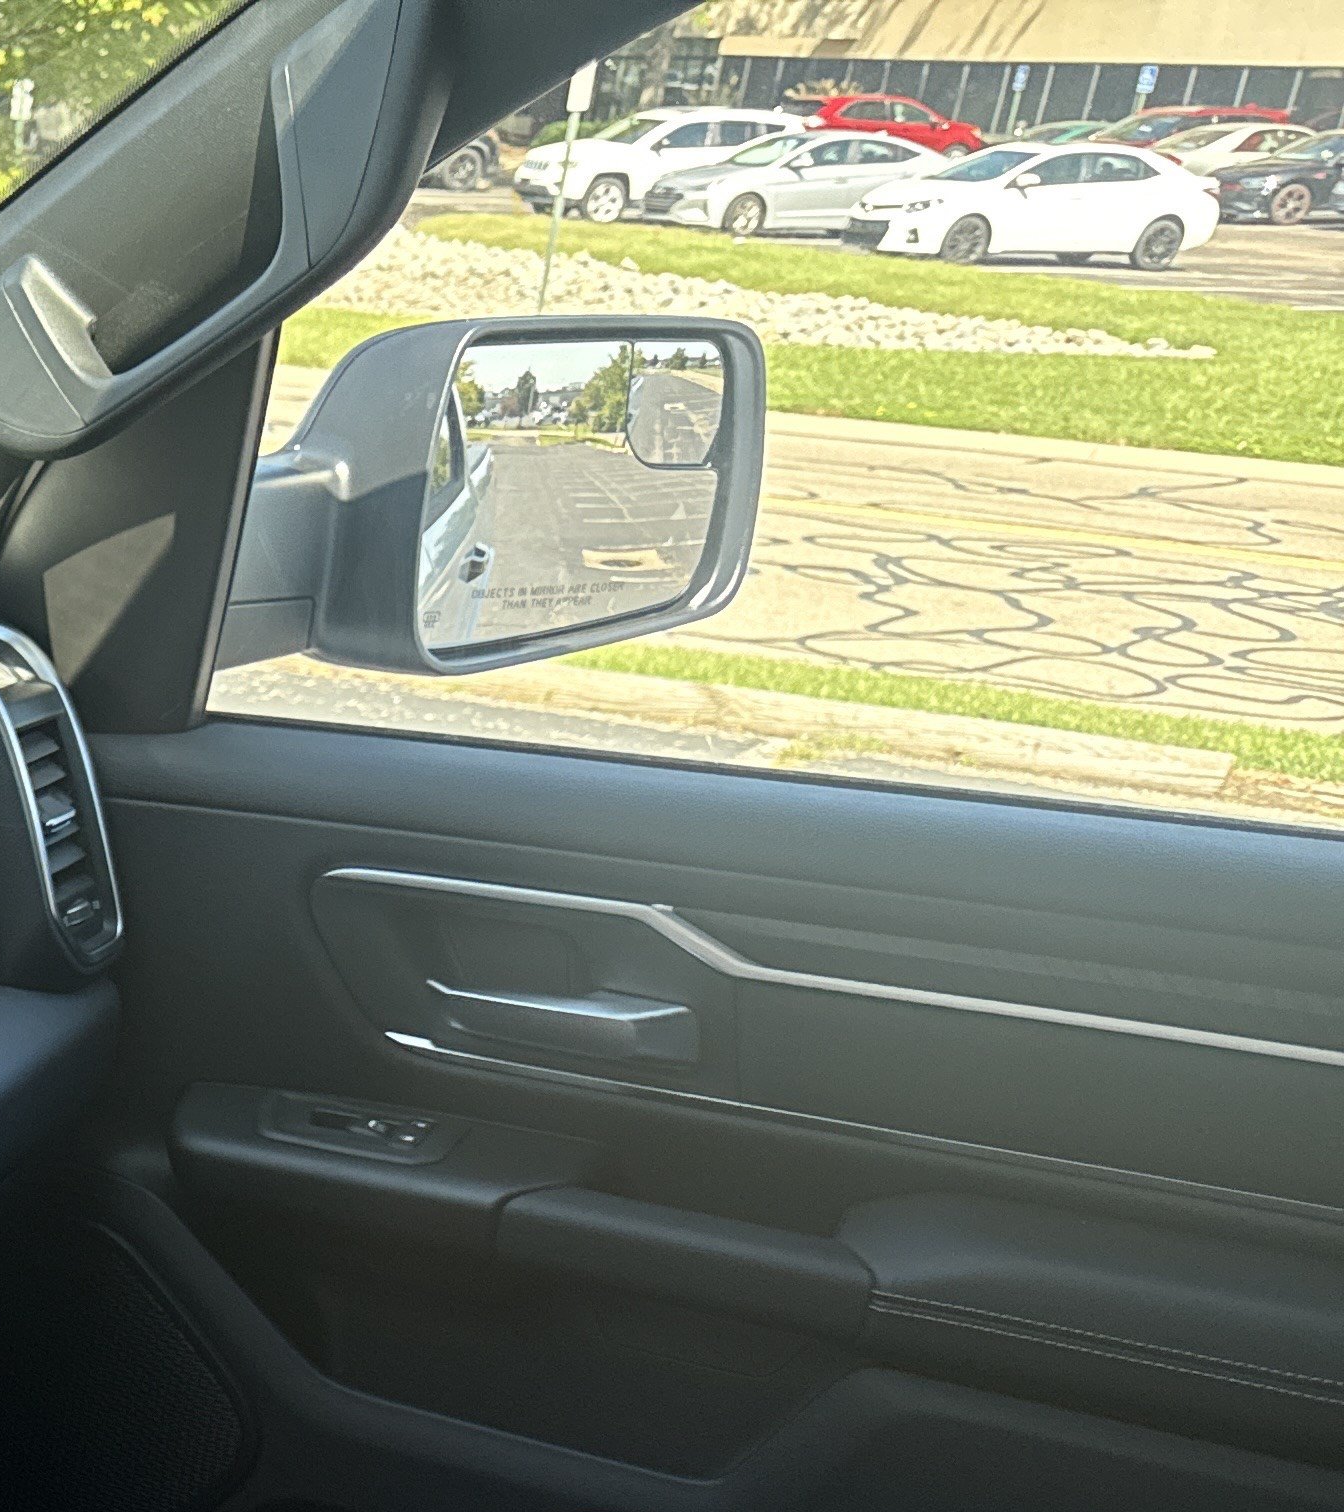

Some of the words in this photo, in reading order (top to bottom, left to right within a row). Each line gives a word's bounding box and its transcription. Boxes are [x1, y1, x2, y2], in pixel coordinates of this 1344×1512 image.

[471, 587, 516, 599] OBJECTS
[517, 587, 528, 598] IN
[530, 584, 564, 597] MIRROR
[568, 583, 587, 593] ARE
[590, 582, 624, 593] CLOSER
[502, 599, 526, 609] THAN
[531, 597, 554, 608] THEY
[556, 596, 592, 607] APPEAR
